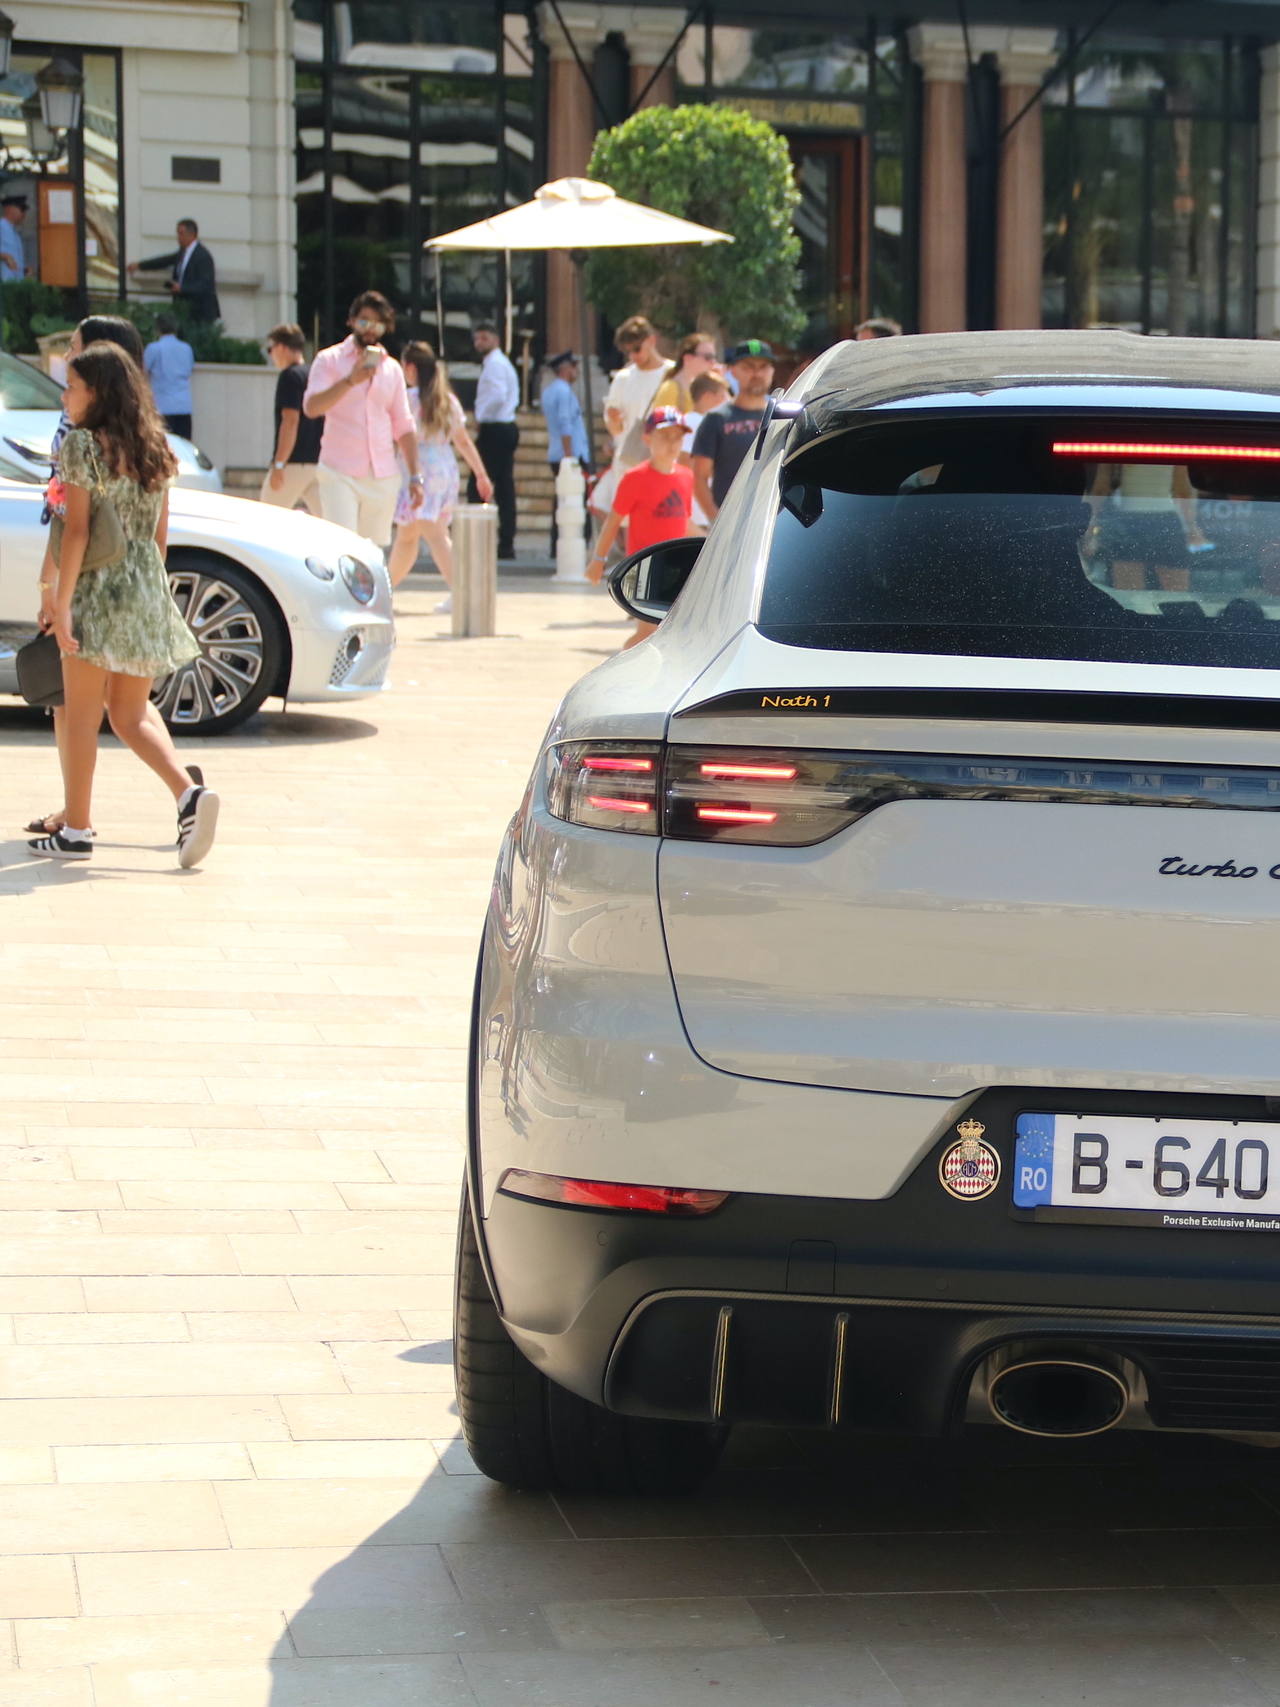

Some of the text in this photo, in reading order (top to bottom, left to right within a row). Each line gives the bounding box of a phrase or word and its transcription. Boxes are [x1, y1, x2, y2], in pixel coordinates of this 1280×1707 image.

[761, 694, 831, 708] Nath 1
[1158, 856, 1259, 879] turbo
[962, 1161, 978, 1177] ACM
[1020, 1166, 1047, 1191] RO
[1163, 1215, 1200, 1226] Porsche
[1201, 1216, 1245, 1228] Exclusive
